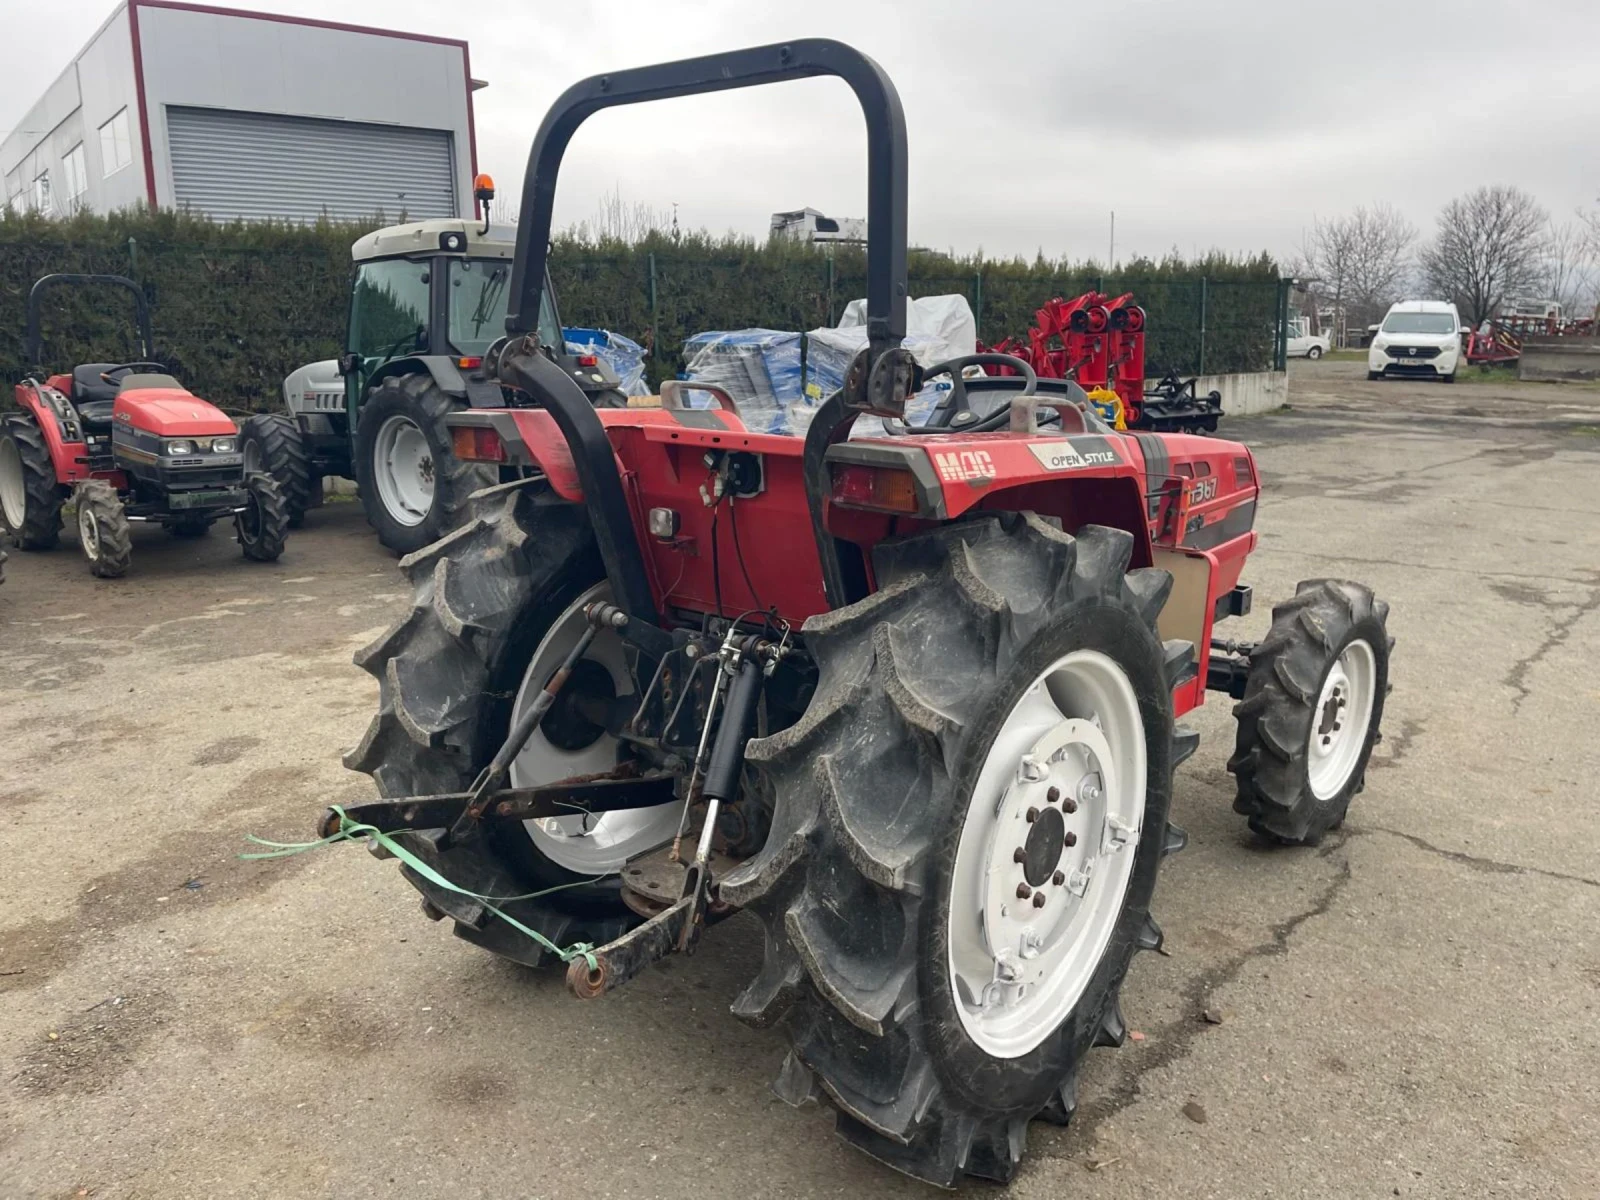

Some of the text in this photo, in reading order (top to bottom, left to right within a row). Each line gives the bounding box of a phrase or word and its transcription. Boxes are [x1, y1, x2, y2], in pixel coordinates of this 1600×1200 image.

[1051, 452, 1115, 467] OPEN STYLE
[1190, 477, 1217, 504] T367
